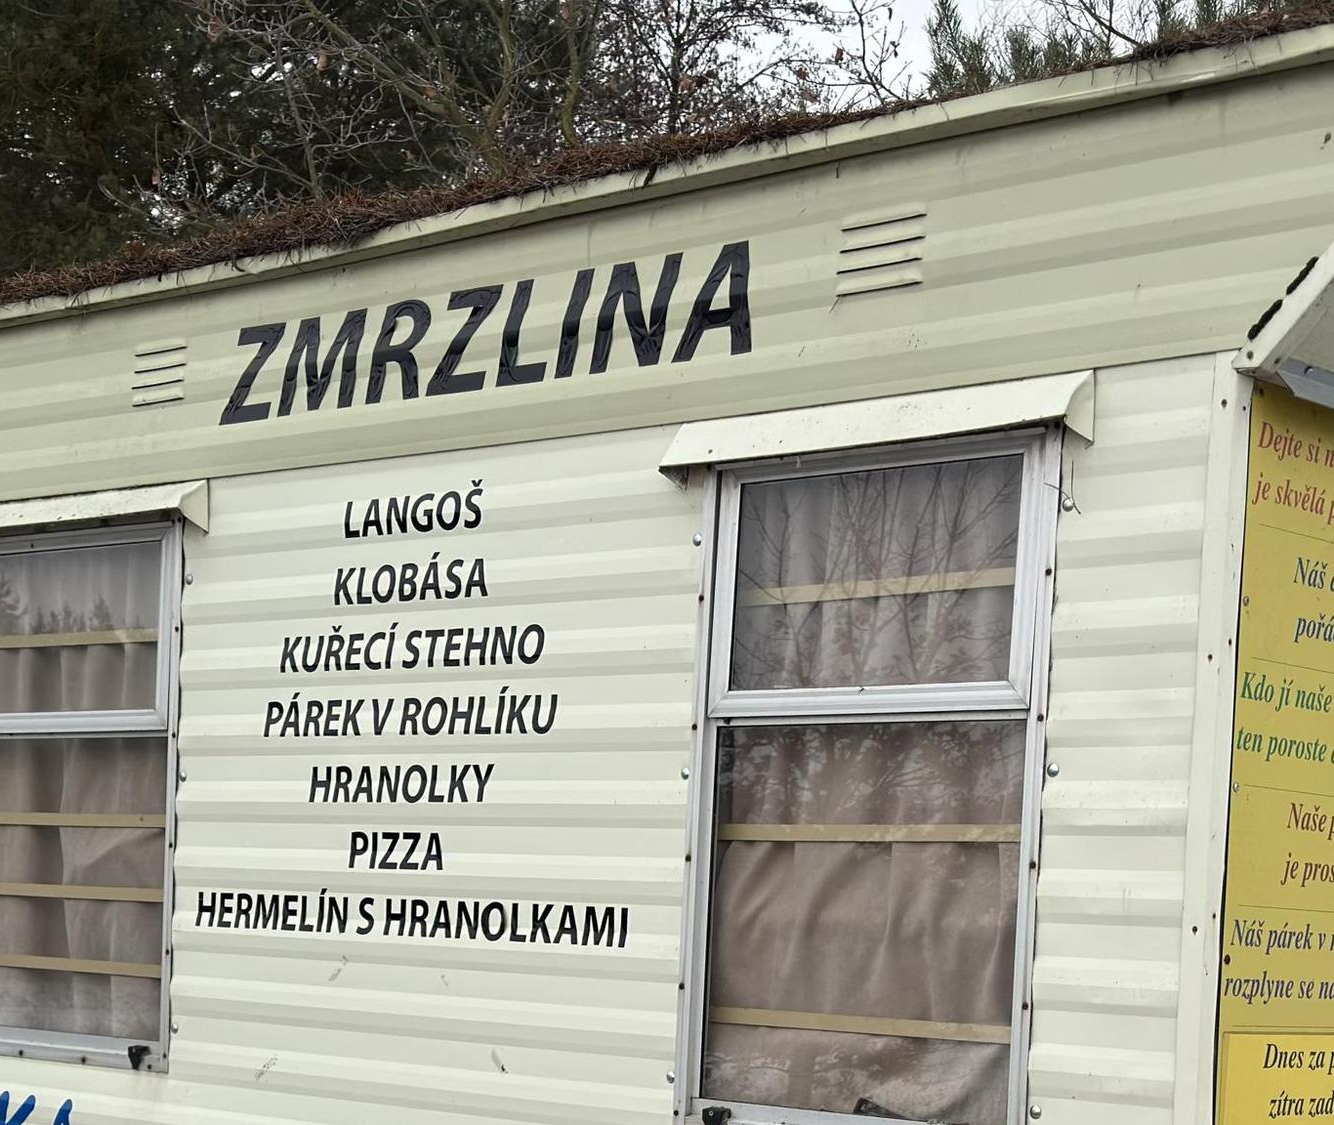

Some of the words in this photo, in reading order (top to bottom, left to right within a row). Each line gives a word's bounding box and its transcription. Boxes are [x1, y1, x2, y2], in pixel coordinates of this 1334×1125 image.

[219, 240, 752, 426] ZMRZLINA
[1258, 421, 1303, 461] Dejte
[1306, 438, 1321, 464] si
[344, 479, 484, 539] LANGOŠ
[1252, 472, 1271, 506] je
[1274, 479, 1327, 516] skvělá
[333, 551, 489, 605] KLOBÁSA
[1293, 557, 1328, 590] Náš
[279, 621, 399, 673] KUŘECÍ
[402, 623, 546, 669] STEHNO
[263, 692, 365, 738] PÁREK
[372, 698, 394, 736] V
[399, 686, 558, 736] ROHLÍKU
[1240, 671, 1275, 703] Kdo
[1275, 678, 1295, 713] jí
[1295, 684, 1332, 713] naše
[1237, 727, 1263, 753] ten
[1264, 733, 1326, 764] poroste
[309, 763, 494, 803] HRANOLKY
[1287, 802, 1327, 833] Naše
[348, 831, 444, 871] PIZZA
[1280, 852, 1299, 886] je
[195, 888, 349, 934] HERMELÍN
[356, 897, 374, 936] S
[383, 898, 629, 949] HRANOLKAMI
[1230, 919, 1264, 948] Náš
[1265, 921, 1313, 955] párek
[1318, 936, 1327, 950] v
[1224, 970, 1294, 1005] rozplyne
[1297, 984, 1314, 999] se
[1262, 1043, 1305, 1069] Dnes
[1308, 1054, 1326, 1070] za
[1268, 1090, 1304, 1119] zítra
